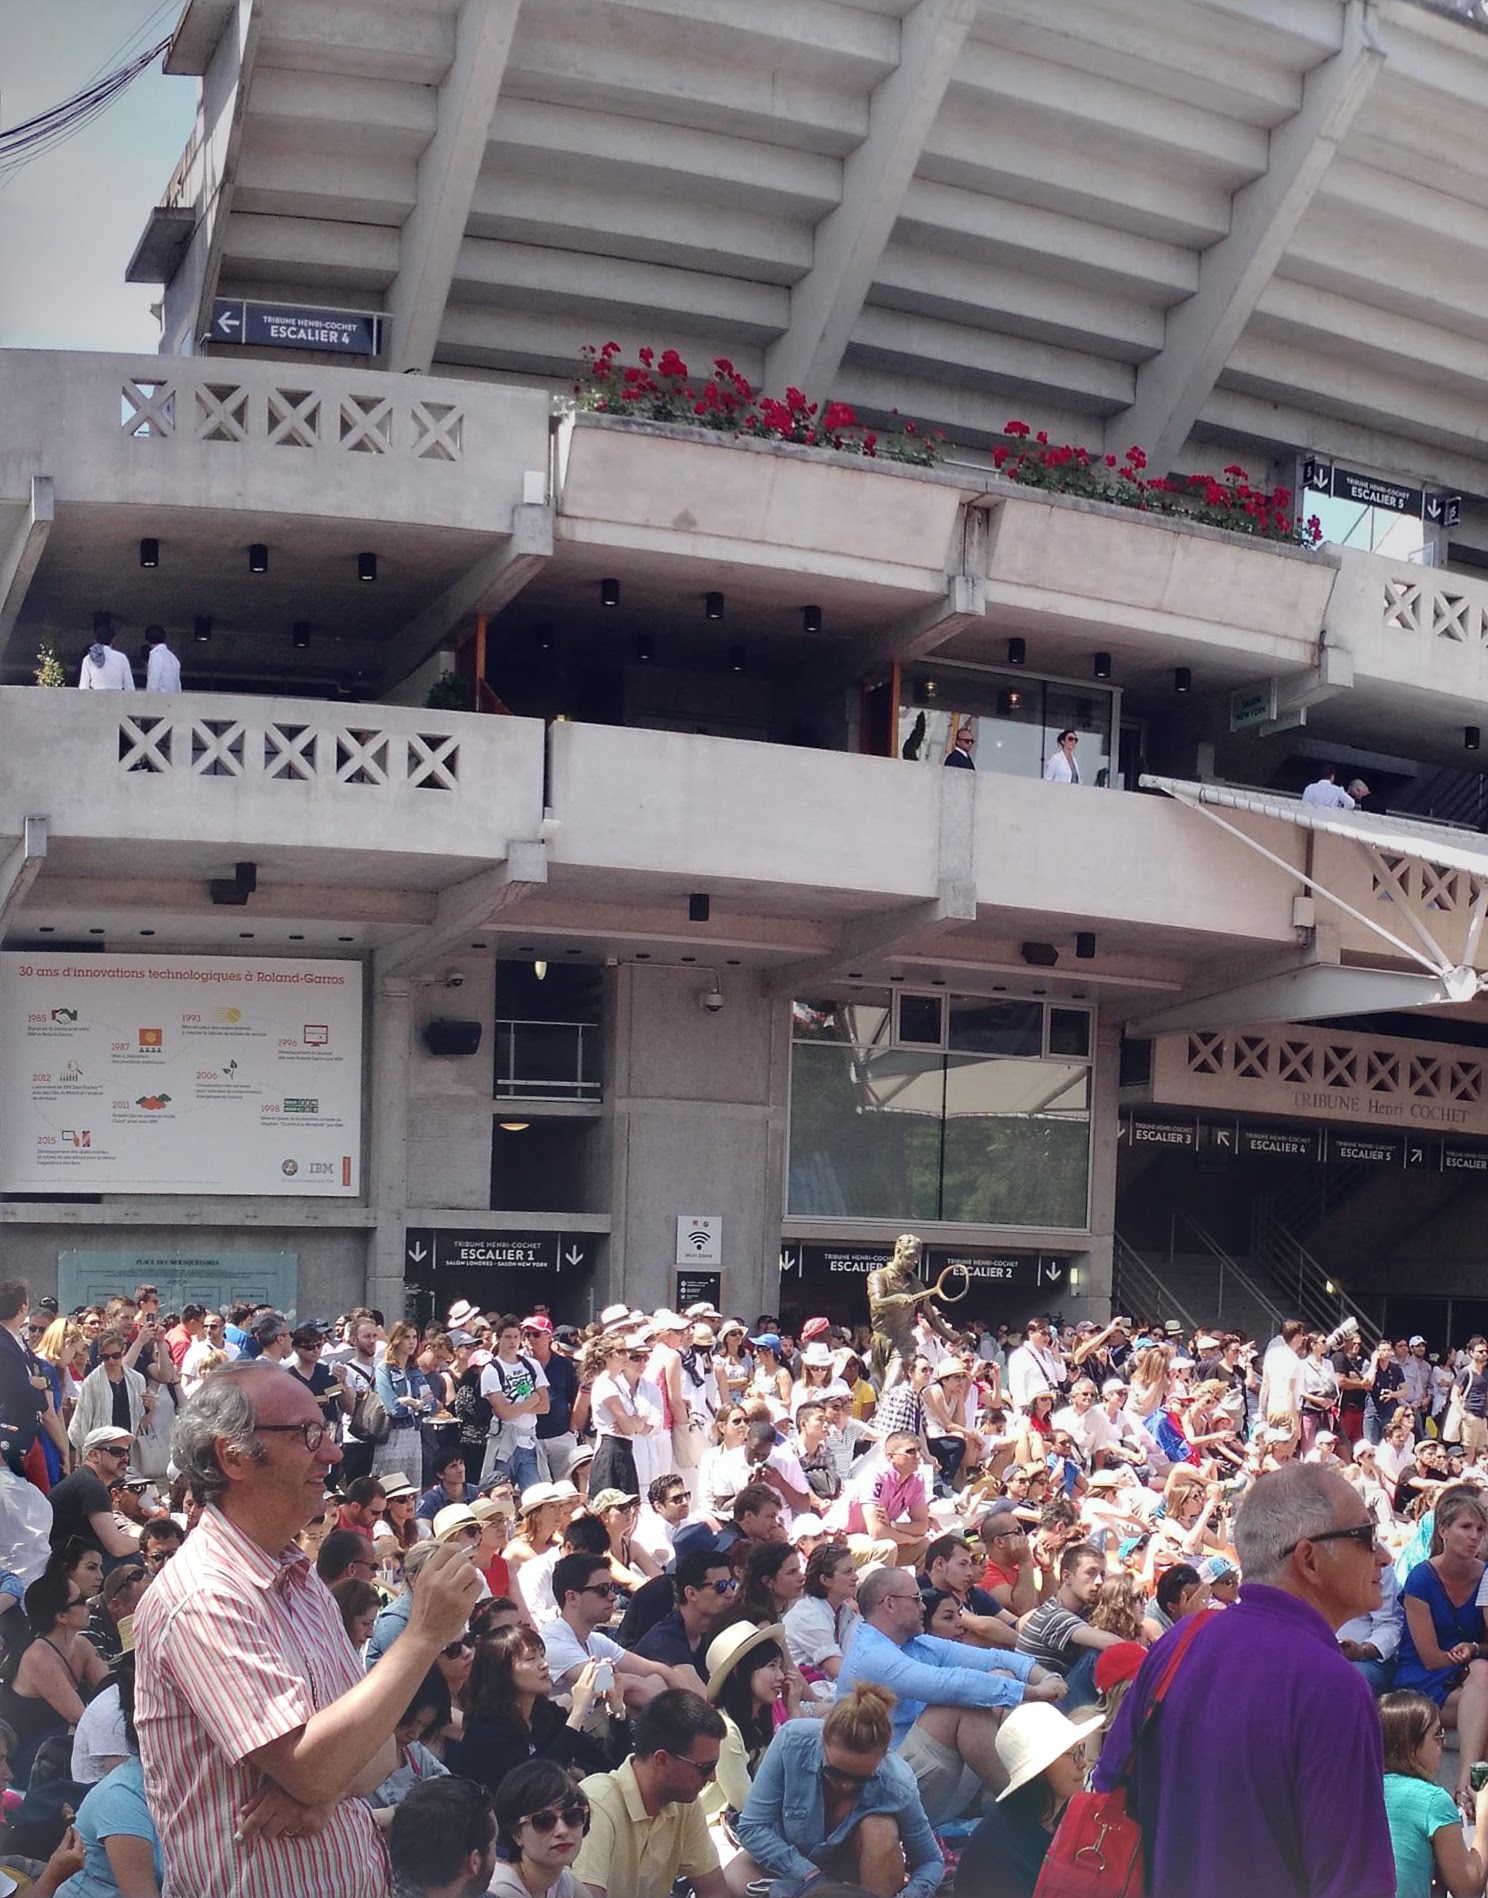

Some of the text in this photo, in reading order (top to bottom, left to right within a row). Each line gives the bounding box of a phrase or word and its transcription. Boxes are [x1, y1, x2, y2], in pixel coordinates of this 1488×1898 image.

[263, 315, 358, 332] TRIBUNE HENRI-COCHET
[270, 325, 350, 344] ESCALIER 4
[1351, 487, 1404, 509] ESCALIER 5
[19, 966, 345, 985] 30 ans d'innovations technologiques à Roland-Garros
[28, 1014, 47, 1023] 1985
[182, 1014, 201, 1023] 1993
[111, 1043, 130, 1051] 1987
[277, 1038, 298, 1047] 1996
[32, 1074, 51, 1082] 2012
[196, 1071, 218, 1080] 2006
[112, 1101, 130, 1109] 2011
[260, 1104, 281, 1113] 1998
[1292, 1090, 1469, 1124] TRIBUNE Henri COCHET
[37, 1136, 56, 1145] 2015
[1136, 1130, 1192, 1144] ESCALIER 3
[1250, 1139, 1306, 1154] ESCALIER 4
[1340, 1148, 1391, 1161] ESCALIER 5
[309, 1163, 334, 1174] IBM
[1446, 1158, 1487, 1170] ESCALIER
[454, 1240, 542, 1249] TRIBUNE HENRI-COCHET
[460, 1249, 535, 1261] ESCALIER 1
[953, 1267, 1013, 1278] ESCALIER 2
